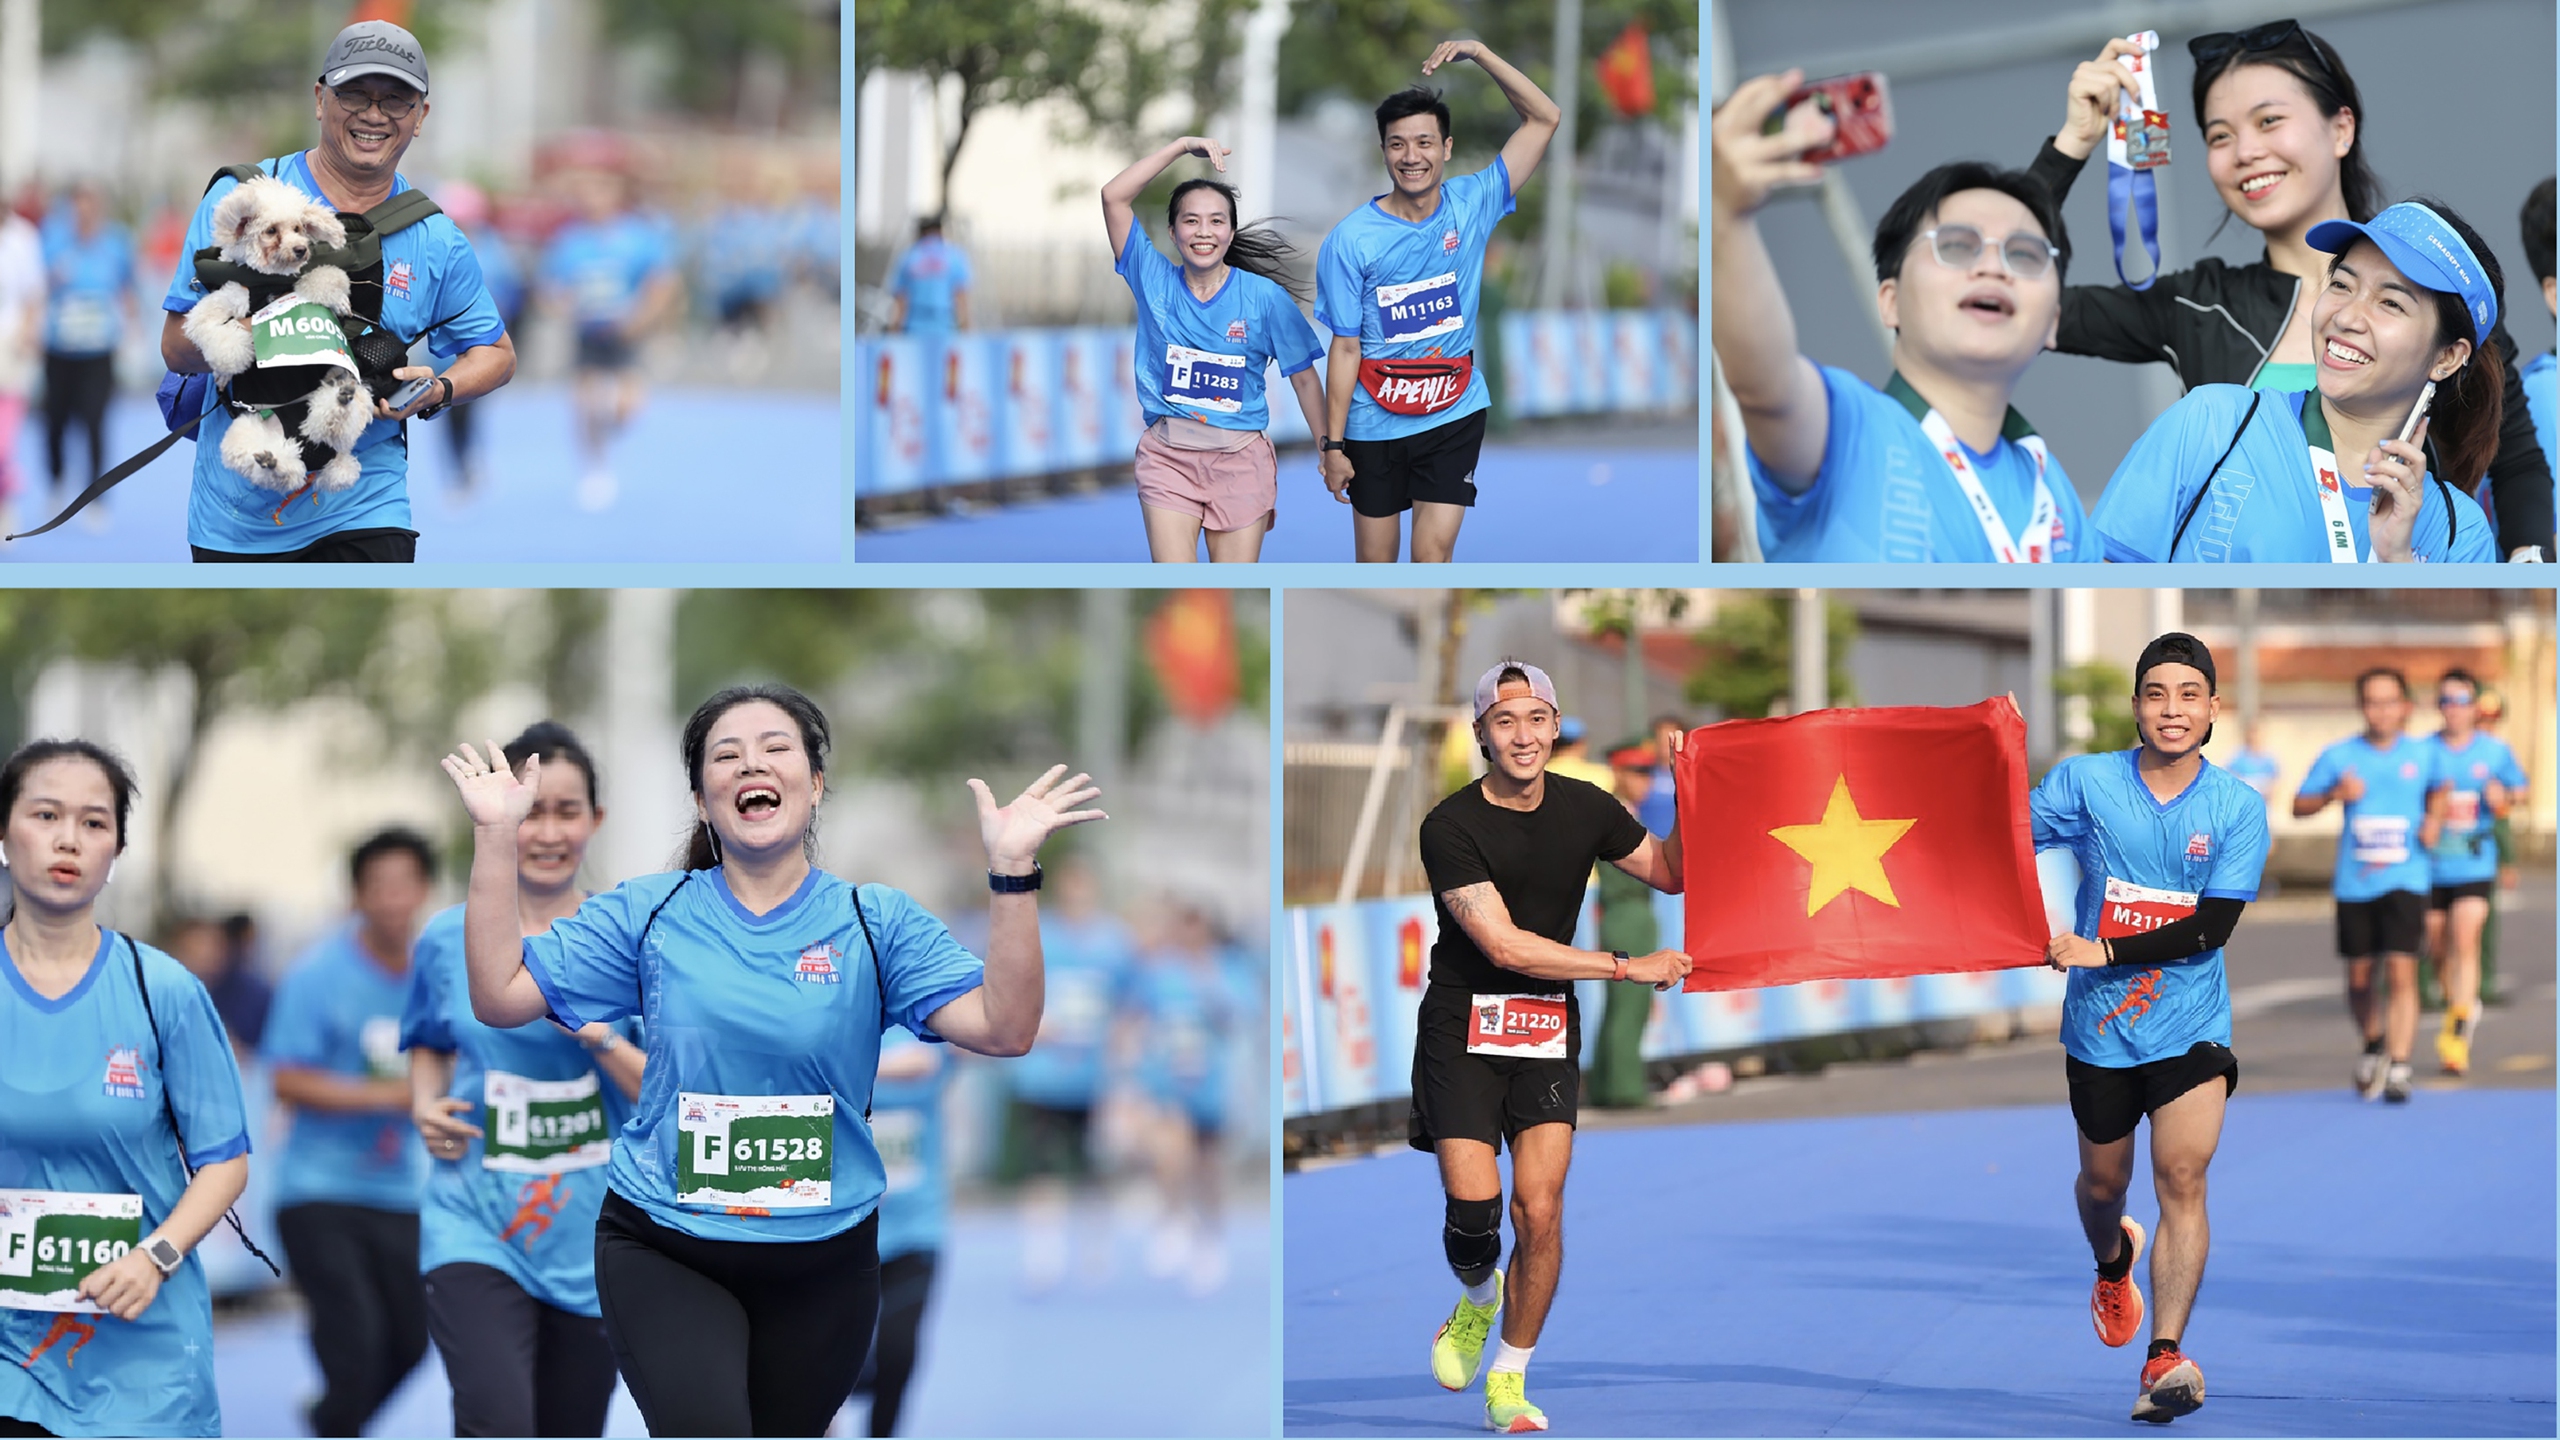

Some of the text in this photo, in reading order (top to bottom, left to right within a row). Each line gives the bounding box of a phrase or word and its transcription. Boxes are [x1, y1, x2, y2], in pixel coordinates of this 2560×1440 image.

[340, 33, 416, 63] Titleist
[2427, 234, 2471, 285] GEMADEPT RUN
[1391, 295, 1453, 320] M11163
[1194, 371, 1239, 390] 11283
[2334, 530, 2348, 548] KM
[2112, 904, 2180, 930] M211
[1506, 1011, 1560, 1030] 21220
[704, 1135, 823, 1161] F 61528
[9, 1233, 130, 1264] F 61160
